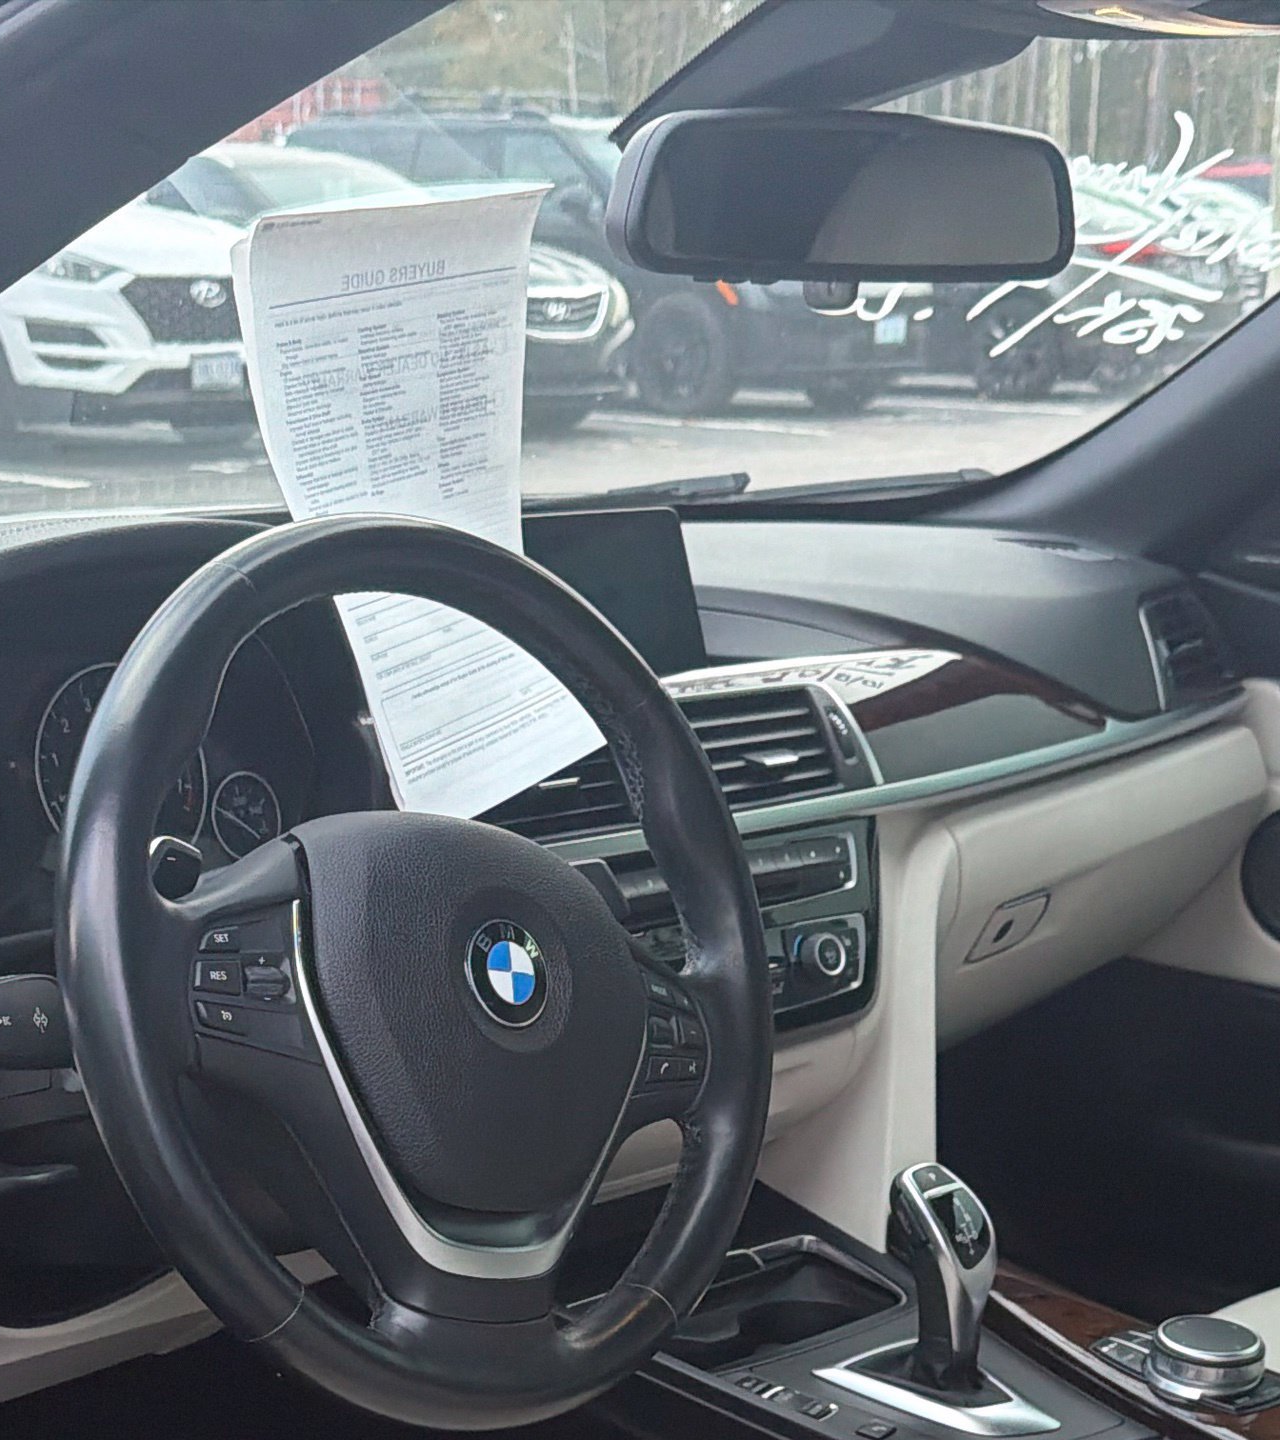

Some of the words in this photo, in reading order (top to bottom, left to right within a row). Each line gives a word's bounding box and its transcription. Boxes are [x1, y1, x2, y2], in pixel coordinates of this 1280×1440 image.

[60, 718, 70, 733] 2
[213, 933, 229, 943] SET
[476, 923, 539, 959] BMW
[209, 970, 228, 981] RES
